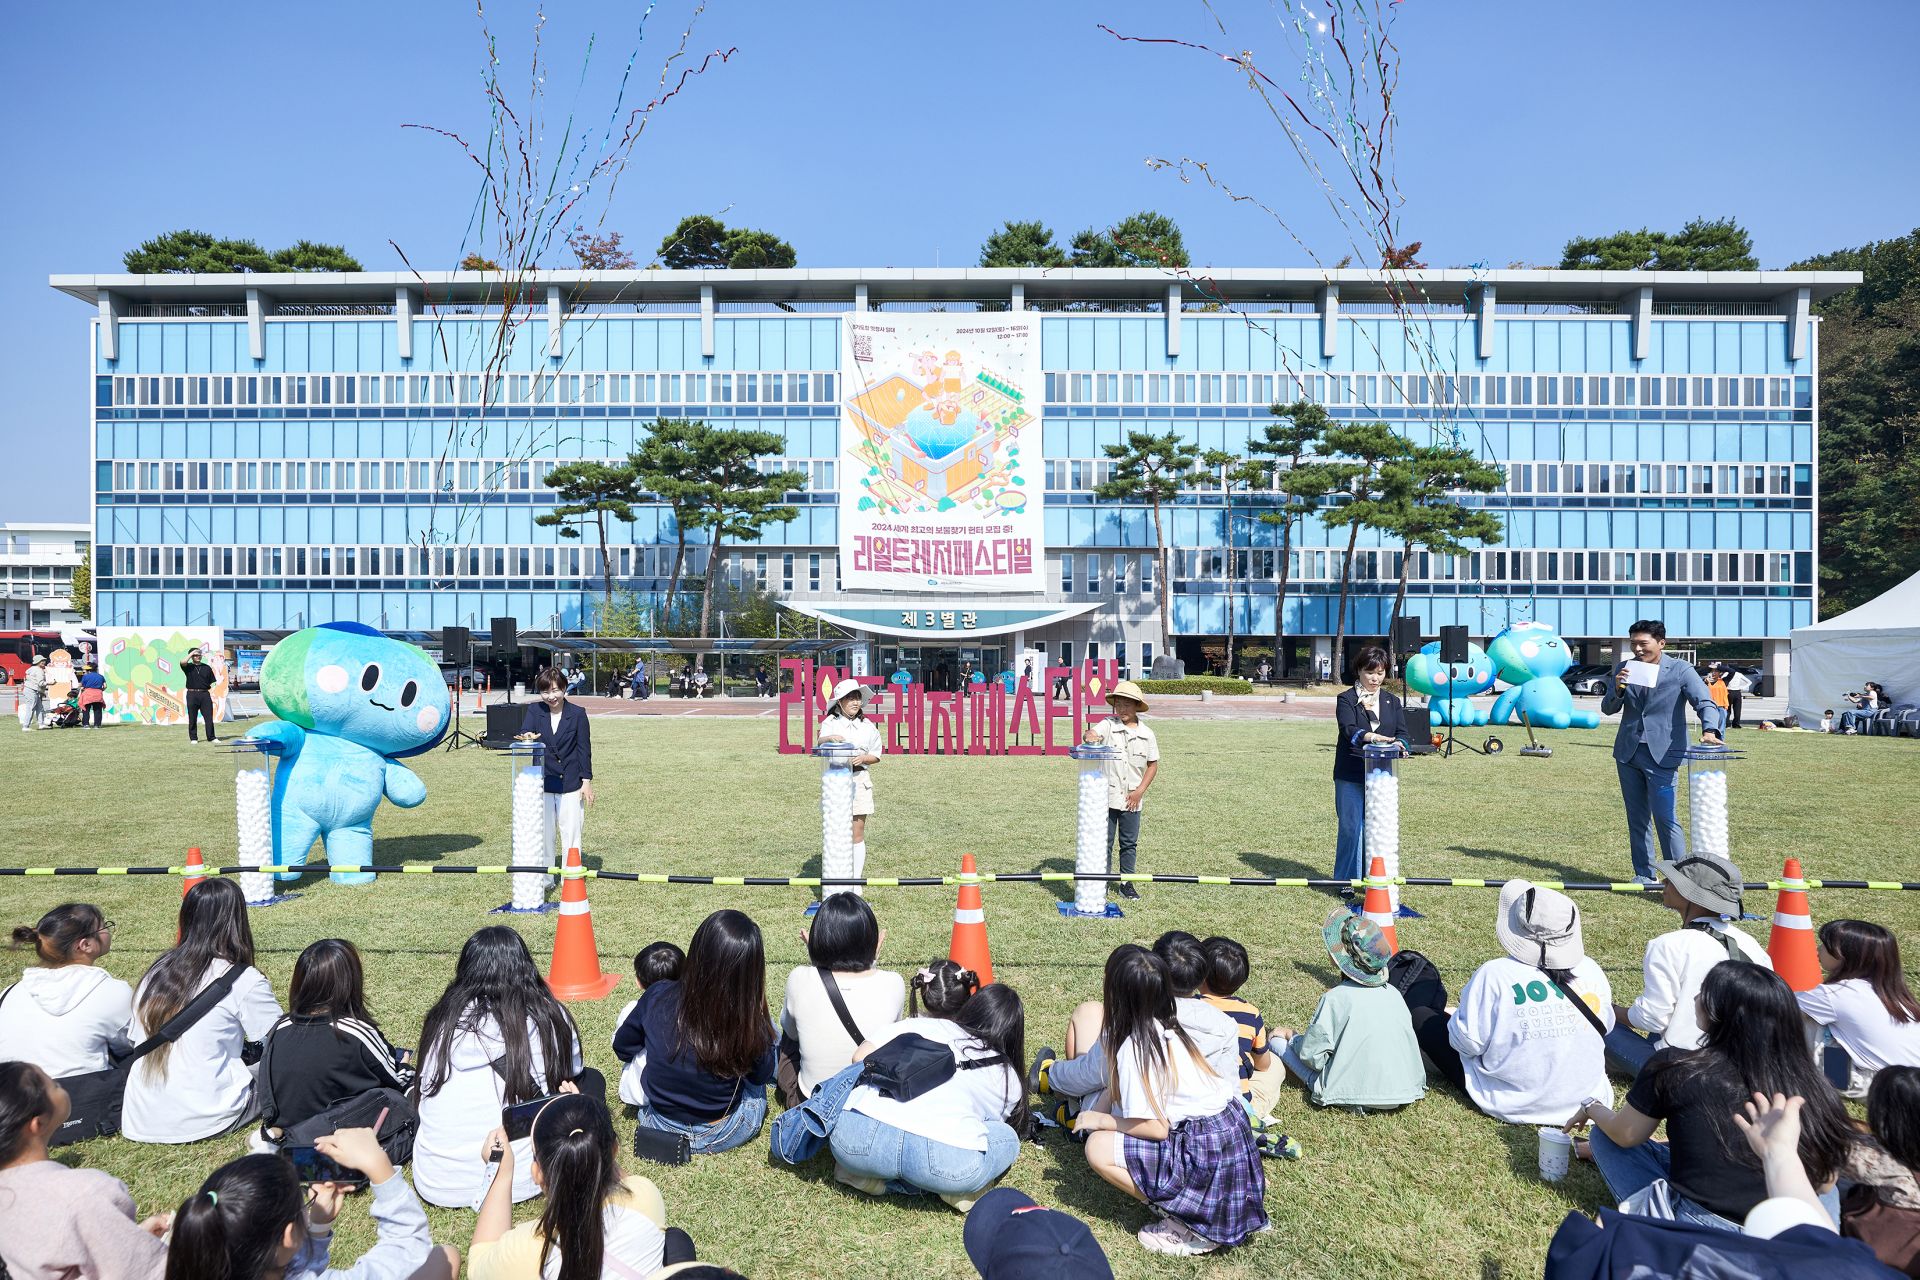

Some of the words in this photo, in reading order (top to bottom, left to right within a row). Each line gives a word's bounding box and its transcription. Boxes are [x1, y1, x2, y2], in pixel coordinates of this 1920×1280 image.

[871, 523, 892, 531] 2024
[893, 525, 908, 533] 세계
[911, 525, 934, 534] 최고의
[935, 526, 966, 535] 보물찾기
[968, 526, 983, 535] 헌터
[985, 525, 1000, 534] 모집
[853, 535, 1033, 576] 리얼트레저페스티벌
[1516, 1004, 1575, 1018] COMES
[1519, 1014, 1576, 1030] EVERY
